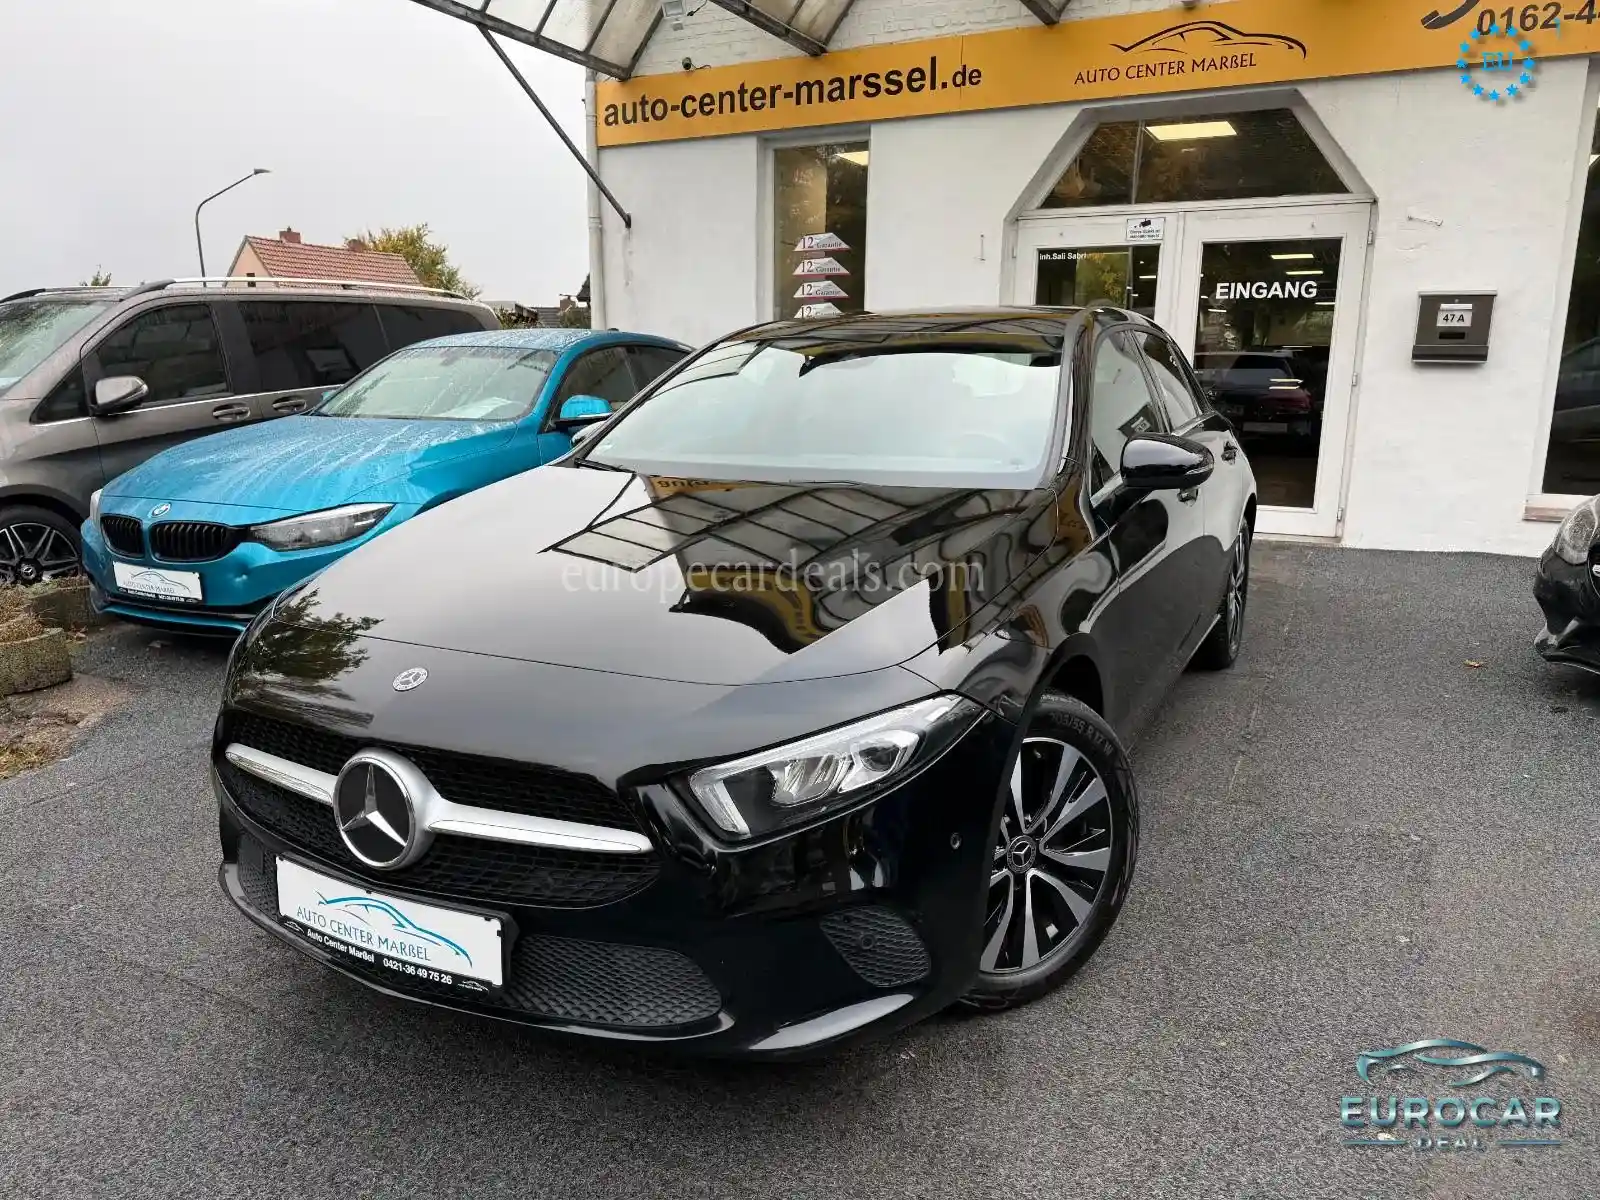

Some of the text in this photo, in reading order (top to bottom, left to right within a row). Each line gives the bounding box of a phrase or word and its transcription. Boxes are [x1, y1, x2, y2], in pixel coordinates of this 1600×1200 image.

[1476, 0, 1600, 36] 0162-4
[1074, 66, 1120, 85] AUTO
[1125, 60, 1185, 79] CENTER
[604, 55, 983, 127] auto-center-marssel.de
[801, 236, 814, 249] 12
[801, 261, 813, 273] 12
[801, 284, 813, 296] 12
[1215, 280, 1318, 300] EINGANG
[1442, 313, 1465, 322] 47 A
[296, 906, 326, 928] AUTO
[329, 919, 373, 945] CENTER
[307, 928, 323, 943] Auto
[323, 934, 348, 953] Center
[382, 957, 416, 976] 0421-36
[416, 968, 428, 979] 49
[429, 970, 440, 982] 75
[441, 973, 453, 985] 26
